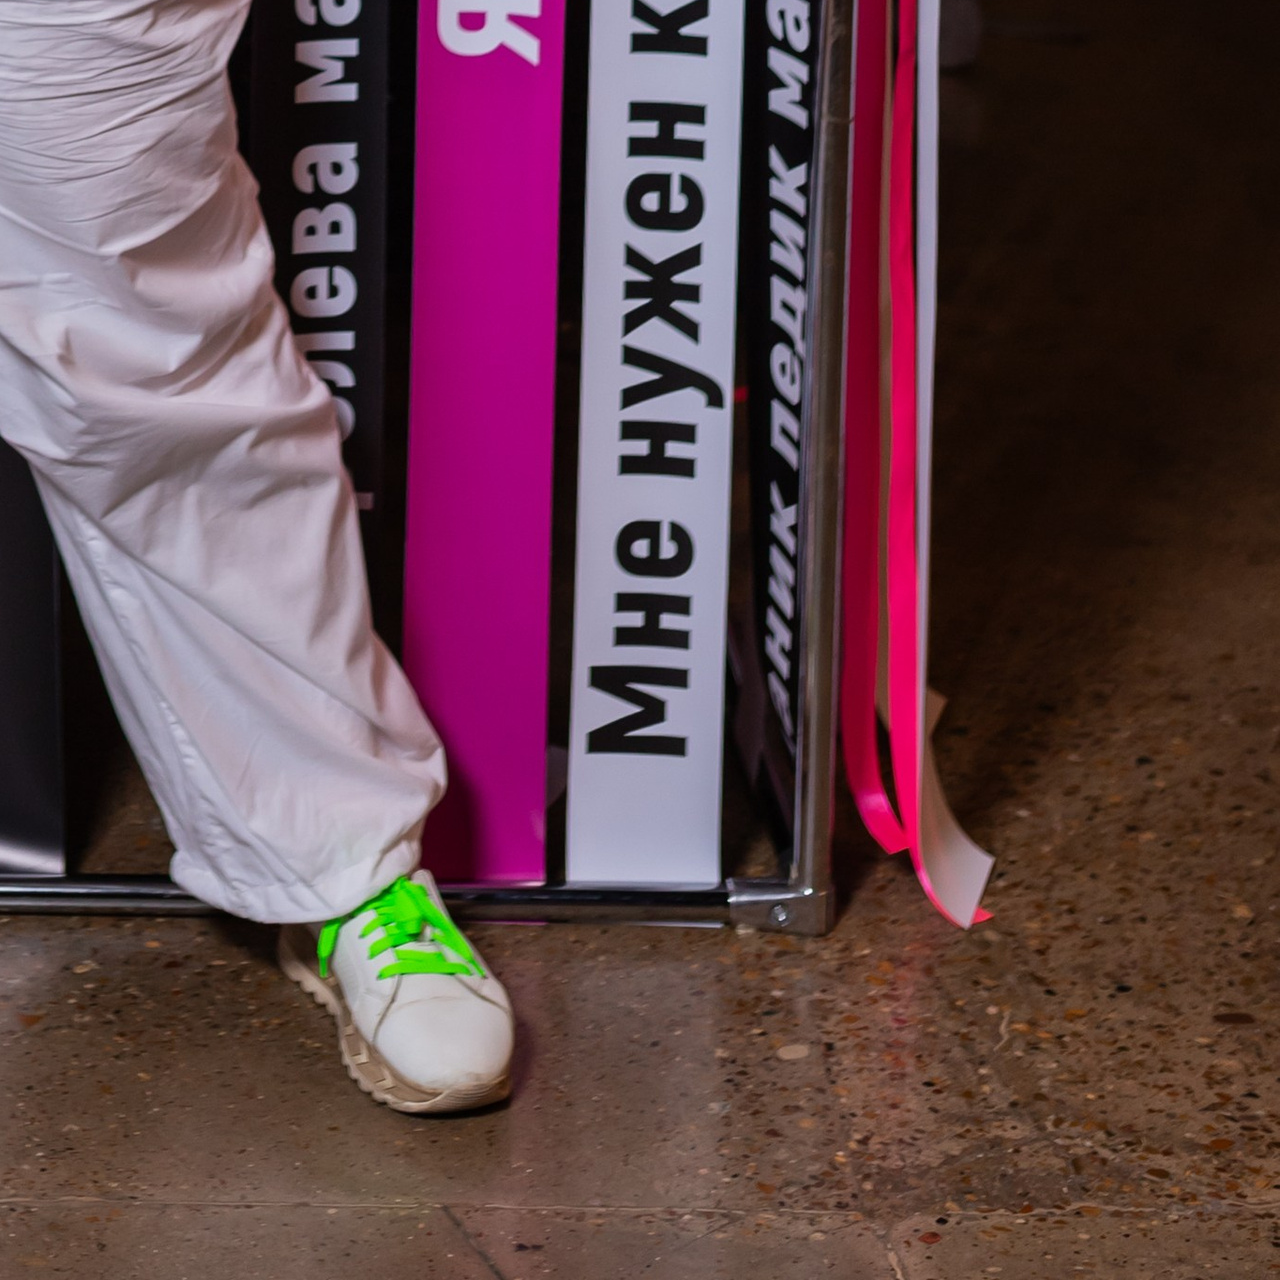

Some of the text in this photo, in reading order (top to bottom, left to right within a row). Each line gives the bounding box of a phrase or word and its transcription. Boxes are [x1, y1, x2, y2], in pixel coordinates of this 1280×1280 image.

[618, 100, 726, 480] нужен
[767, 145, 809, 470] педик
[586, 519, 695, 759] Мне
